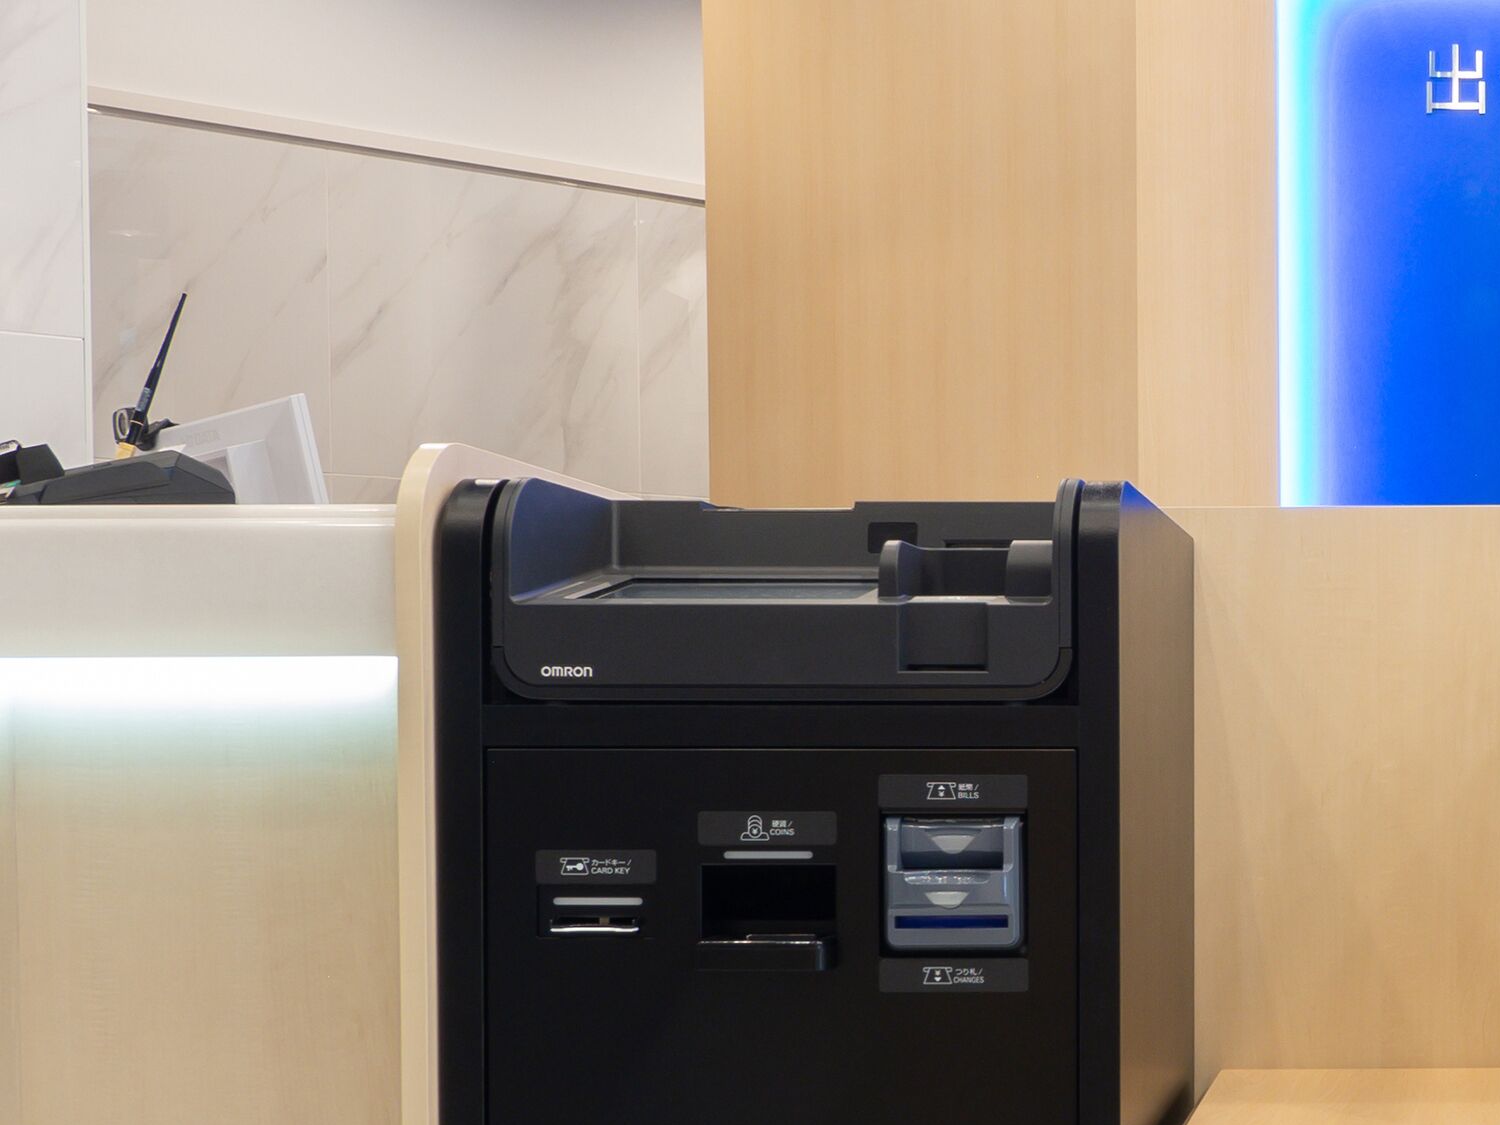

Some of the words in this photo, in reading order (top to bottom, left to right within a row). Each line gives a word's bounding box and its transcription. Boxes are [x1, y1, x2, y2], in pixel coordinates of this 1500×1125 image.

[957, 792, 980, 800] BILLS
[769, 828, 795, 837] COINS
[590, 867, 614, 875] CARD
[614, 867, 631, 875] KEY
[953, 976, 985, 985] CHANGES
